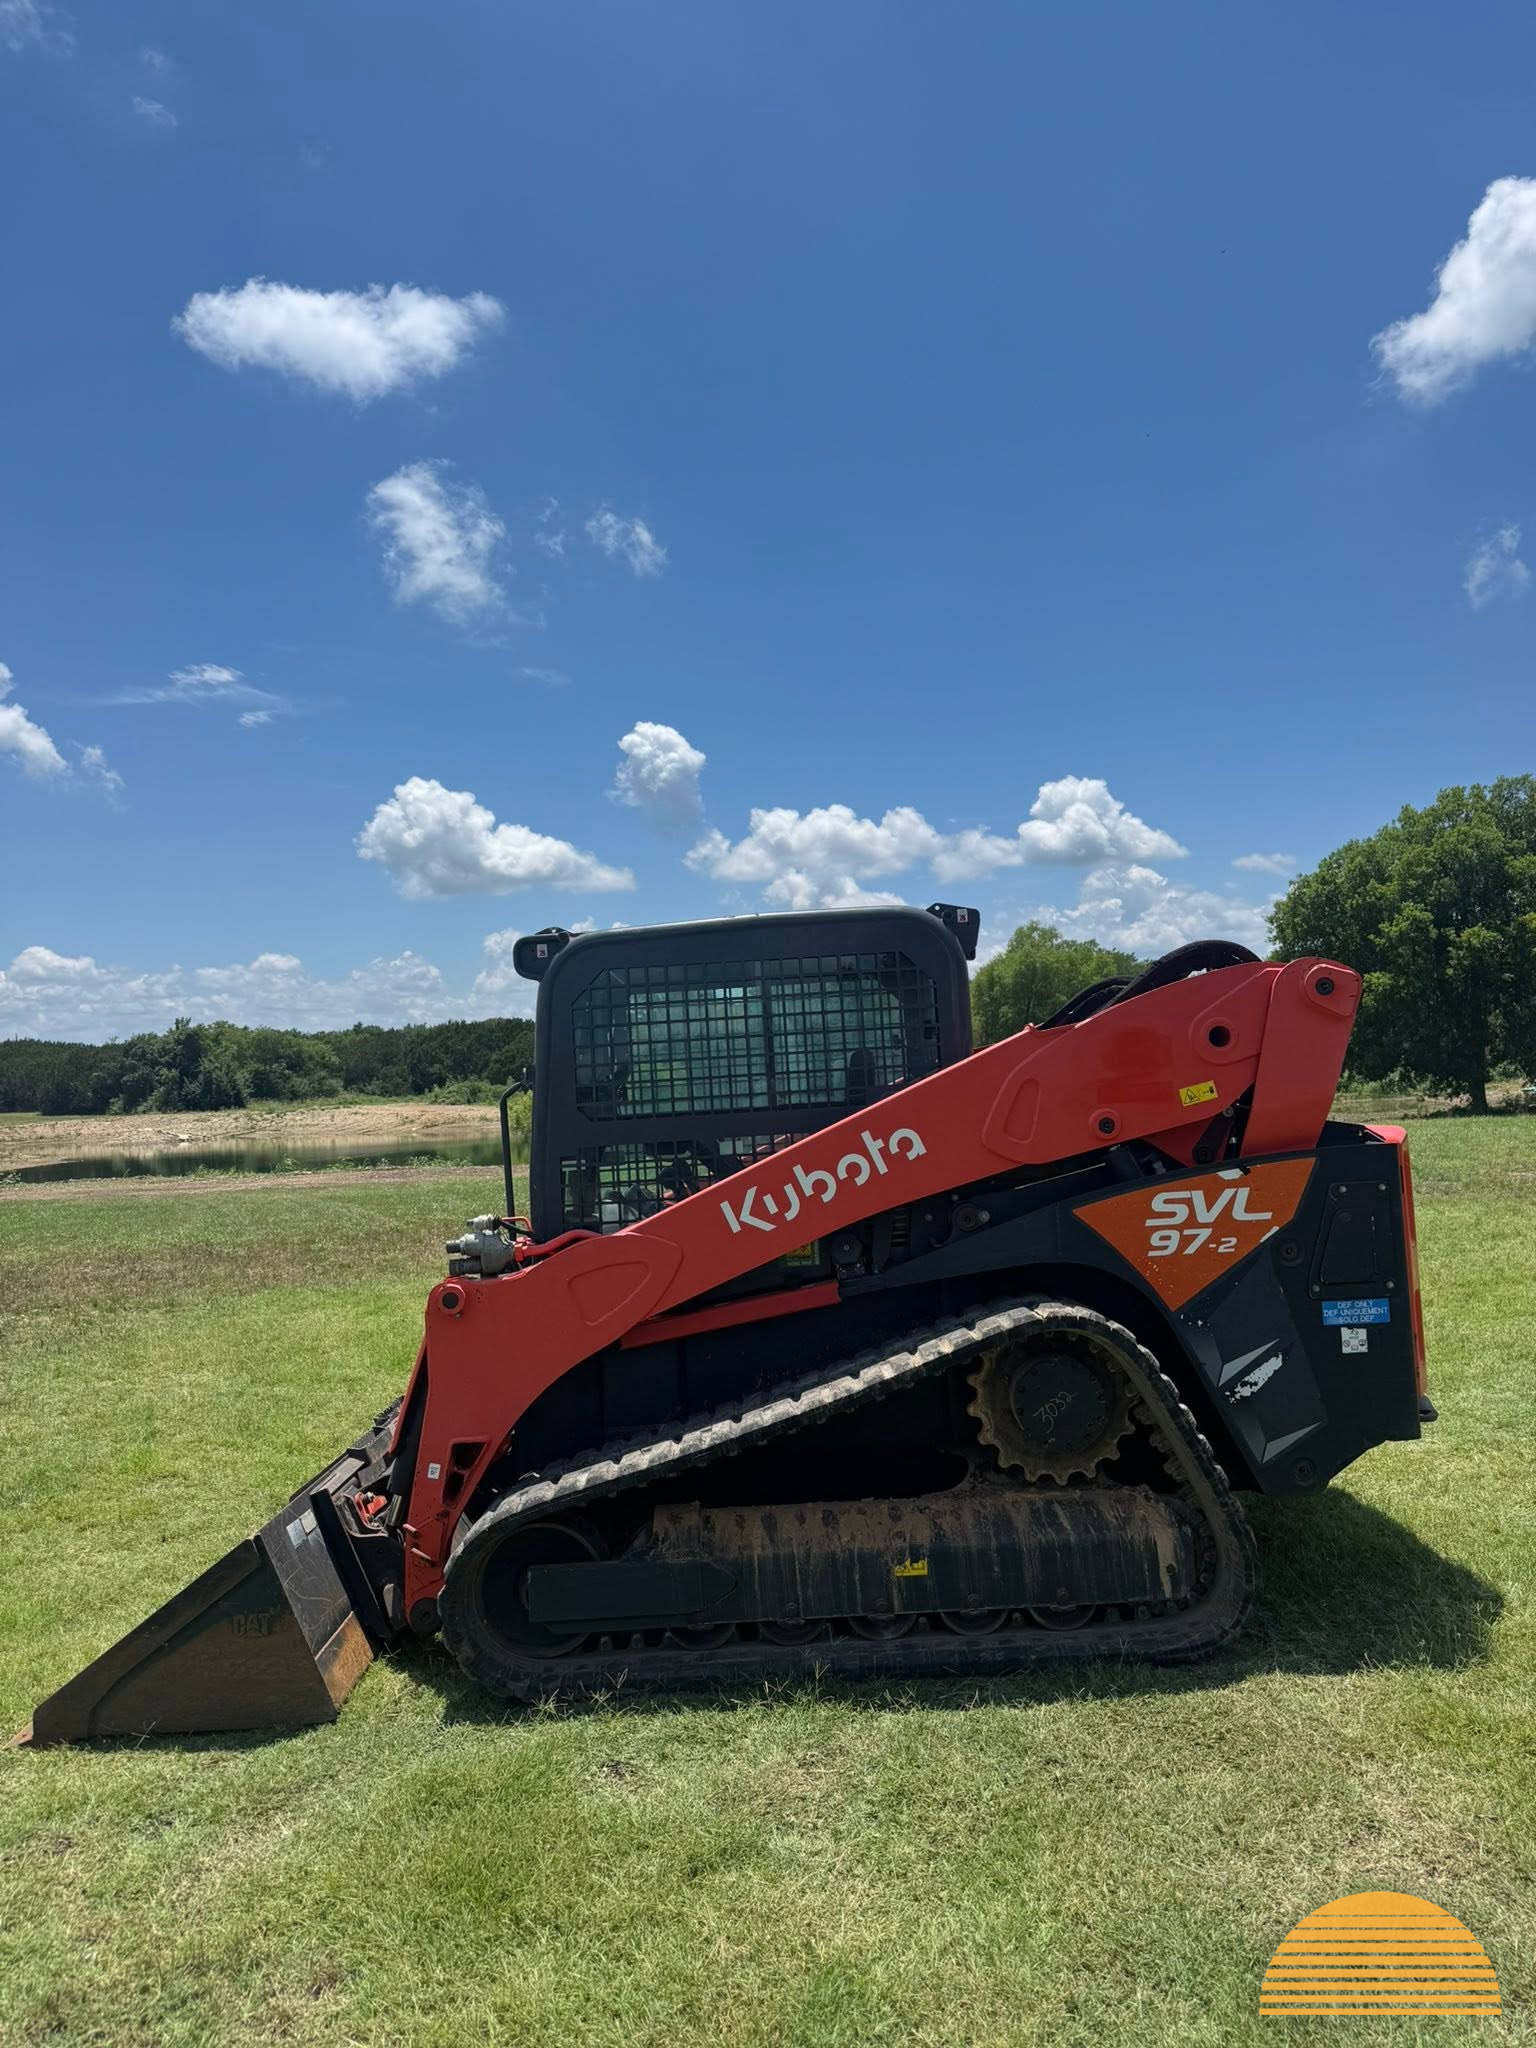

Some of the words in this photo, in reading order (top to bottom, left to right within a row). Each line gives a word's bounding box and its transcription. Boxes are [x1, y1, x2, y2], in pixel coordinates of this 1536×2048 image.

[720, 1128, 927, 1233] Kubota
[1145, 1187, 1273, 1226] SVL
[1148, 1228, 1237, 1257] 97-2
[1323, 1309, 1339, 1317] DEF
[1340, 1306, 1388, 1316] UNIQUEMENT
[1337, 1301, 1352, 1309] DEF
[1354, 1300, 1374, 1308] ONLY
[232, 1613, 271, 1636] CAT
